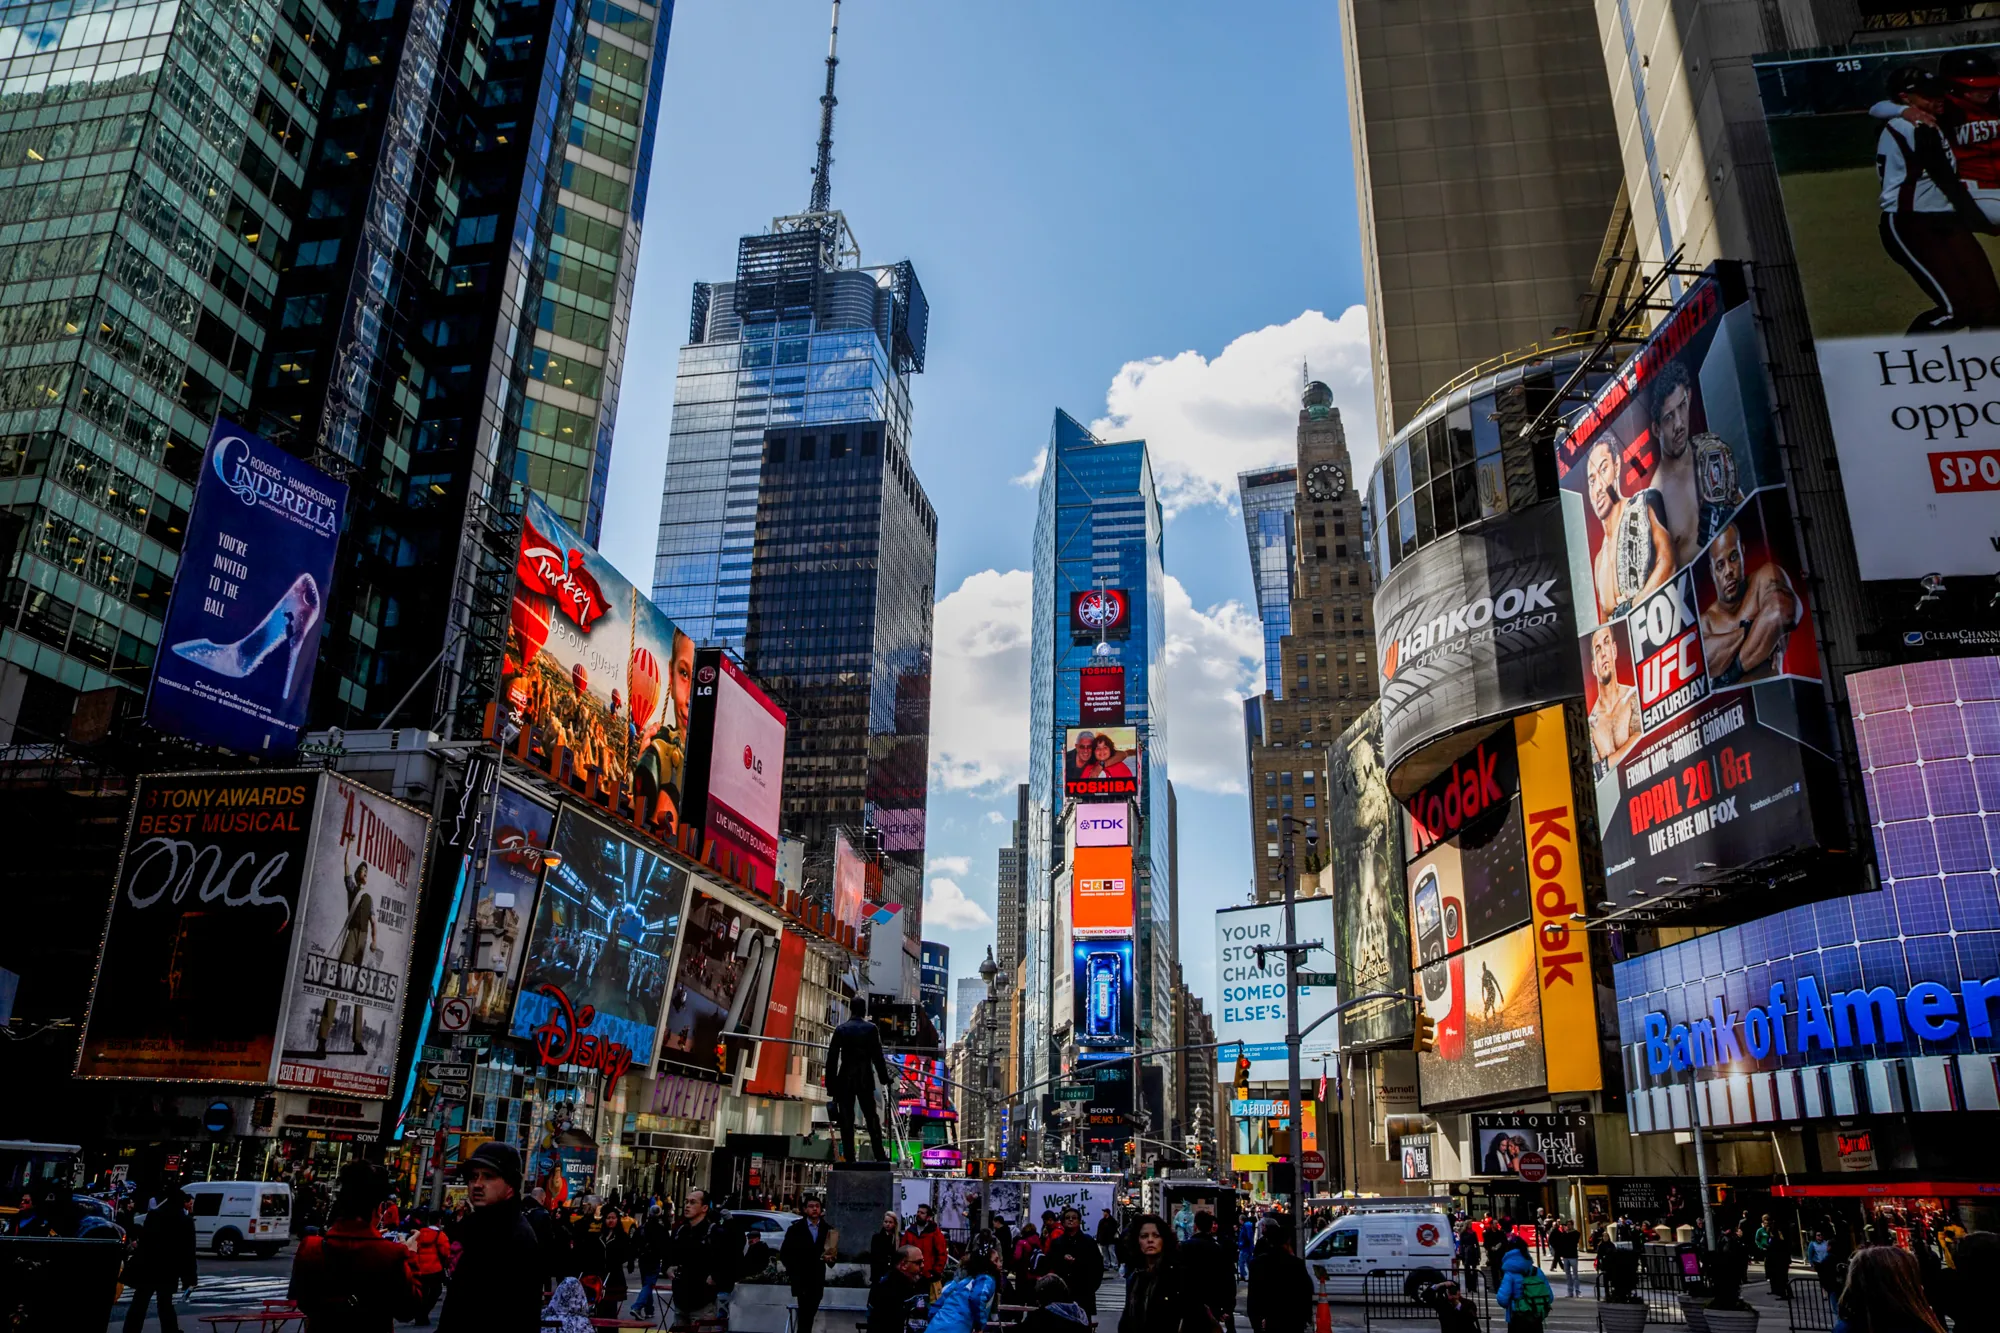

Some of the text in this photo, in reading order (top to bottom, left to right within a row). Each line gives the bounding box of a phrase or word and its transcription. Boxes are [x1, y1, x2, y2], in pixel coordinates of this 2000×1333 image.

[1836, 60, 1862, 73] 215
[250, 456, 337, 511] RODGERS HAMMERSTEIN'S
[218, 531, 249, 558] YOU'RE
[213, 553, 248, 581] INVITED
[208, 574, 240, 601] TO THE
[524, 547, 591, 626] Turkey
[203, 596, 225, 619] BALL
[1637, 573, 1696, 665] FOX
[550, 605, 619, 681] be our guest
[1415, 610, 1558, 670] driving emotion
[729, 665, 736, 678] LG
[1081, 666, 1124, 676] TOSHIBA
[1640, 632, 1699, 703] UFC
[194, 679, 272, 715] CinderellaOnBroadway.com
[697, 686, 713, 696] LG
[1643, 676, 1709, 731] SATURDAY
[1641, 708, 1720, 758] HEAVYWEIGHT BATTLE
[304, 743, 344, 756] LAMAR
[1625, 704, 1746, 790] FRANK MIR DANIEL CORMIER
[752, 754, 762, 775] LG
[161, 784, 307, 810] TONY AWARDS
[1067, 780, 1136, 794] TOSHIBA
[1410, 742, 1505, 855] Kodak
[1628, 776, 1683, 836] APRIL
[1682, 759, 1714, 810] 20
[139, 810, 302, 835] BEST MUSICAL
[716, 811, 750, 844] LIVE WITHOUT
[1090, 818, 1124, 830] TDK
[1648, 827, 1668, 856] LIVE
[1673, 816, 1695, 845] FREE
[1693, 811, 1710, 836] ON
[1708, 795, 1740, 829] FOX
[516, 870, 524, 879] our
[1529, 805, 1584, 992] Kodak
[1222, 923, 1271, 943] YOUR
[304, 954, 399, 1001] NEWSIES
[1308, 974, 1315, 985] W
[1316, 974, 1327, 985] 46
[303, 985, 314, 993] THE
[315, 987, 329, 997] TONY
[373, 1001, 393, 1011] MUSICAL
[1223, 1004, 1286, 1023] ELSE'S.
[467, 1035, 482, 1047] W 46
[1644, 994, 1746, 1077] Bank
[1745, 980, 1789, 1062] of
[294, 1066, 307, 1083] THE
[437, 1067, 467, 1076] ONE WAY
[651, 1071, 721, 1121] FOREVER
[1060, 1090, 1090, 1099] Broadway
[1379, 1085, 1415, 1095] Marriott
[1090, 1115, 1114, 1125] BREAKS
[1478, 1115, 1587, 1127] MARQUIS
[356, 1133, 380, 1143] SONY
[1535, 1131, 1577, 1153] Jekyll
[1837, 1132, 1872, 1158] Marriott
[1542, 1148, 1585, 1169] Hyde
[1043, 1187, 1093, 1209] Wear it.
